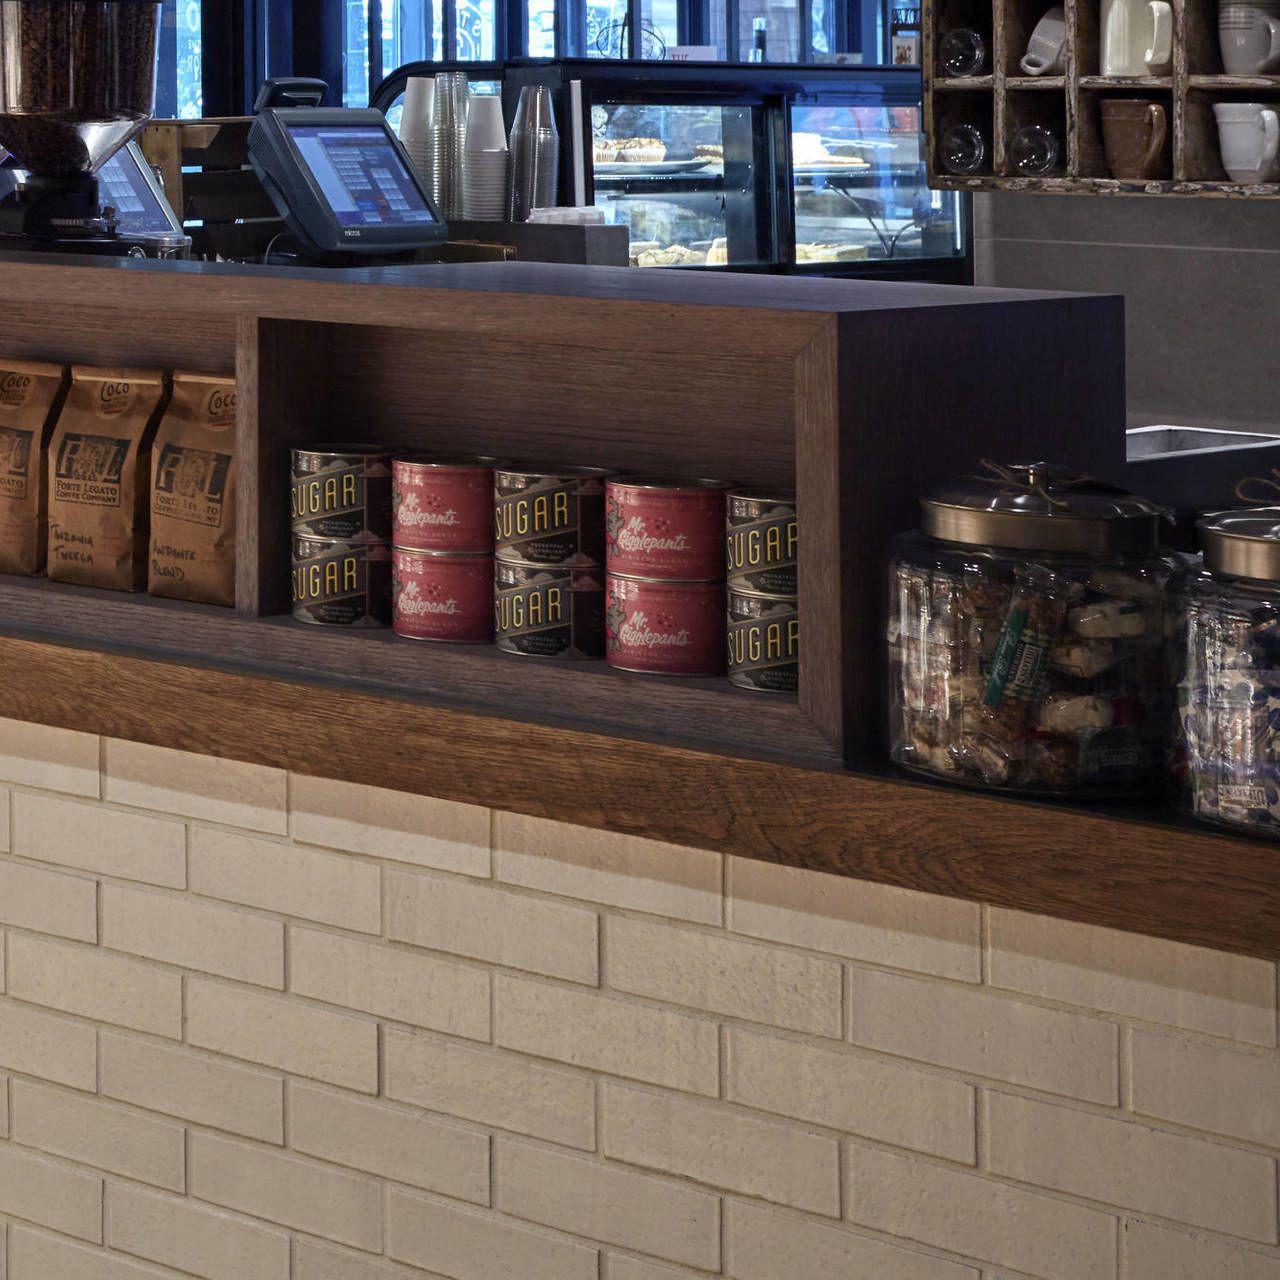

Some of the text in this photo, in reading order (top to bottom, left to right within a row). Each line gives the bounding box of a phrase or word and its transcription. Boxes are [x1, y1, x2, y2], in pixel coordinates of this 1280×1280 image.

[57, 480, 118, 496] FORTE LEGATO
[292, 474, 357, 518] SUGAR
[496, 491, 570, 540] SUGAR
[626, 516, 646, 531] Mr.
[618, 530, 693, 552] Gigglepants
[292, 557, 358, 602] SUGAR
[496, 588, 562, 632] SUGAR
[628, 611, 649, 626] Mr.
[619, 624, 694, 647] Gigglepants
